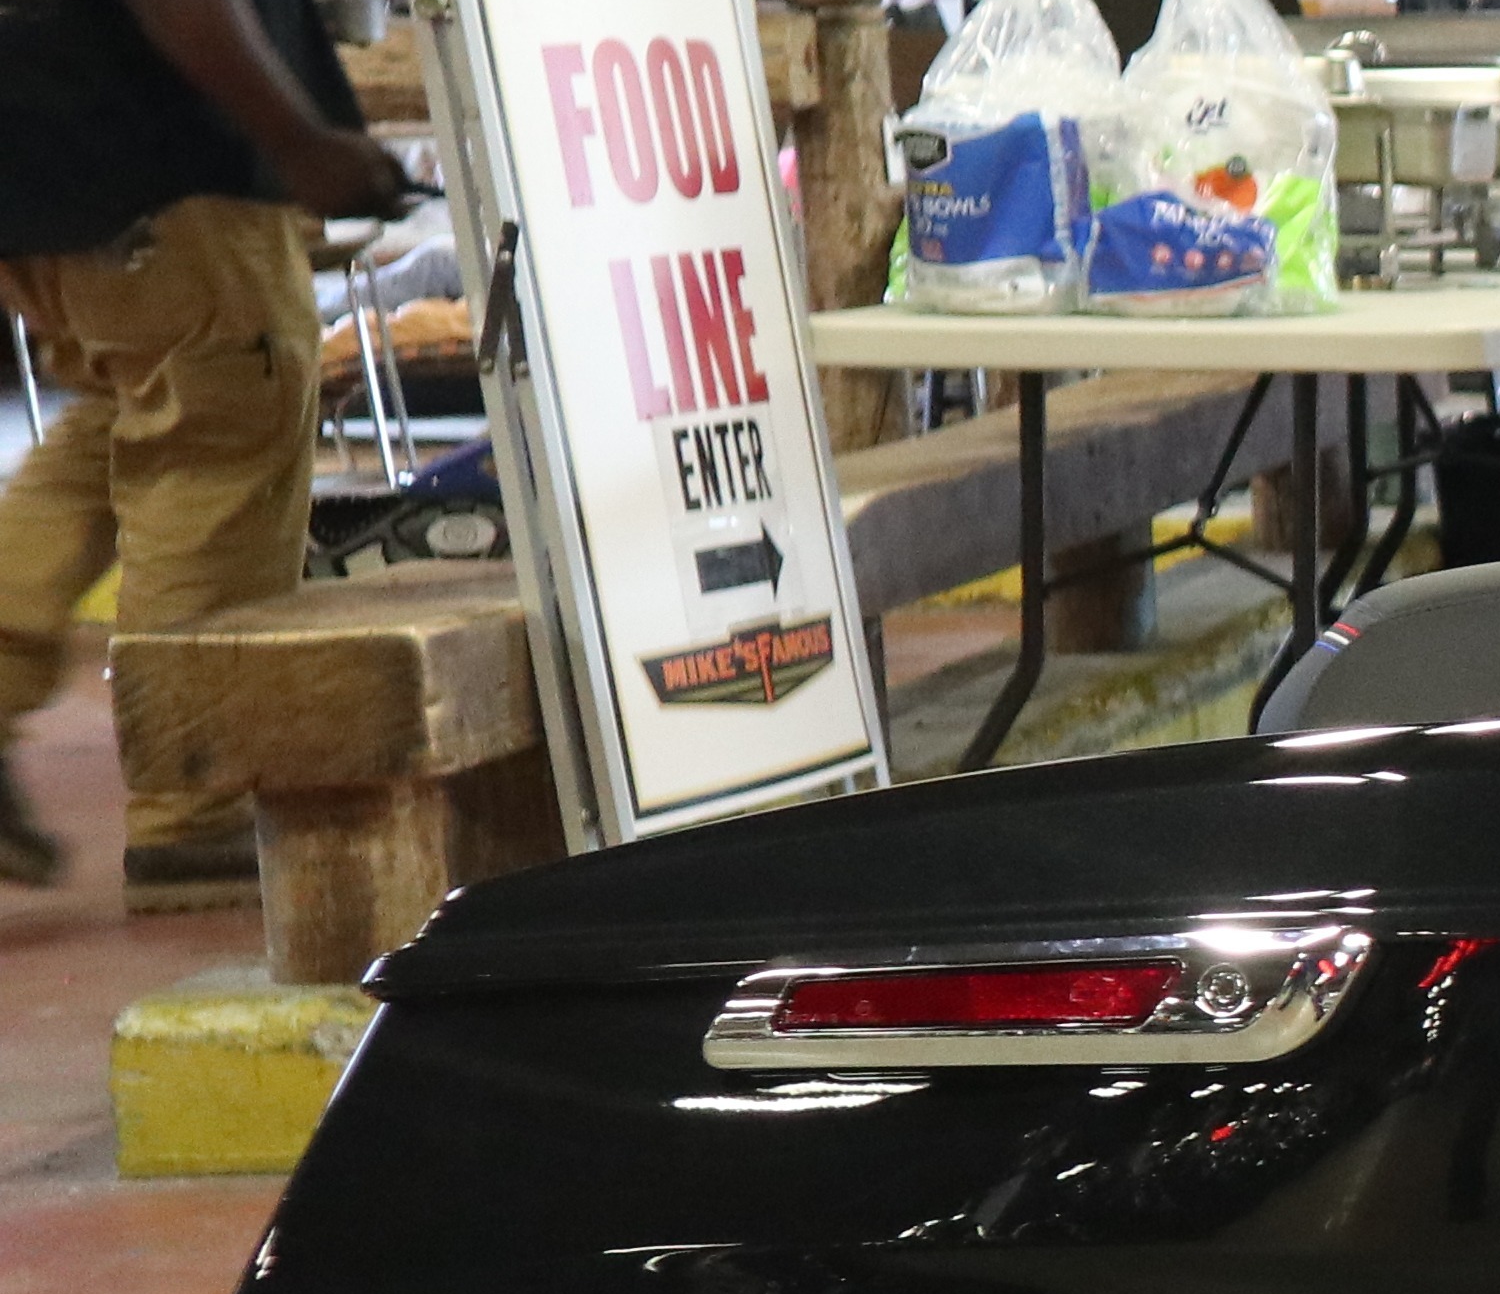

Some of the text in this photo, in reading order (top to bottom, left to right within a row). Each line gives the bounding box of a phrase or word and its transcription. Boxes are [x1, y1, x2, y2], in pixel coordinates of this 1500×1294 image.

[540, 37, 742, 209] FOOD
[607, 248, 769, 423] LINE
[671, 418, 772, 513] ENTER
[661, 622, 831, 704] MIKE'S FAMOUS
